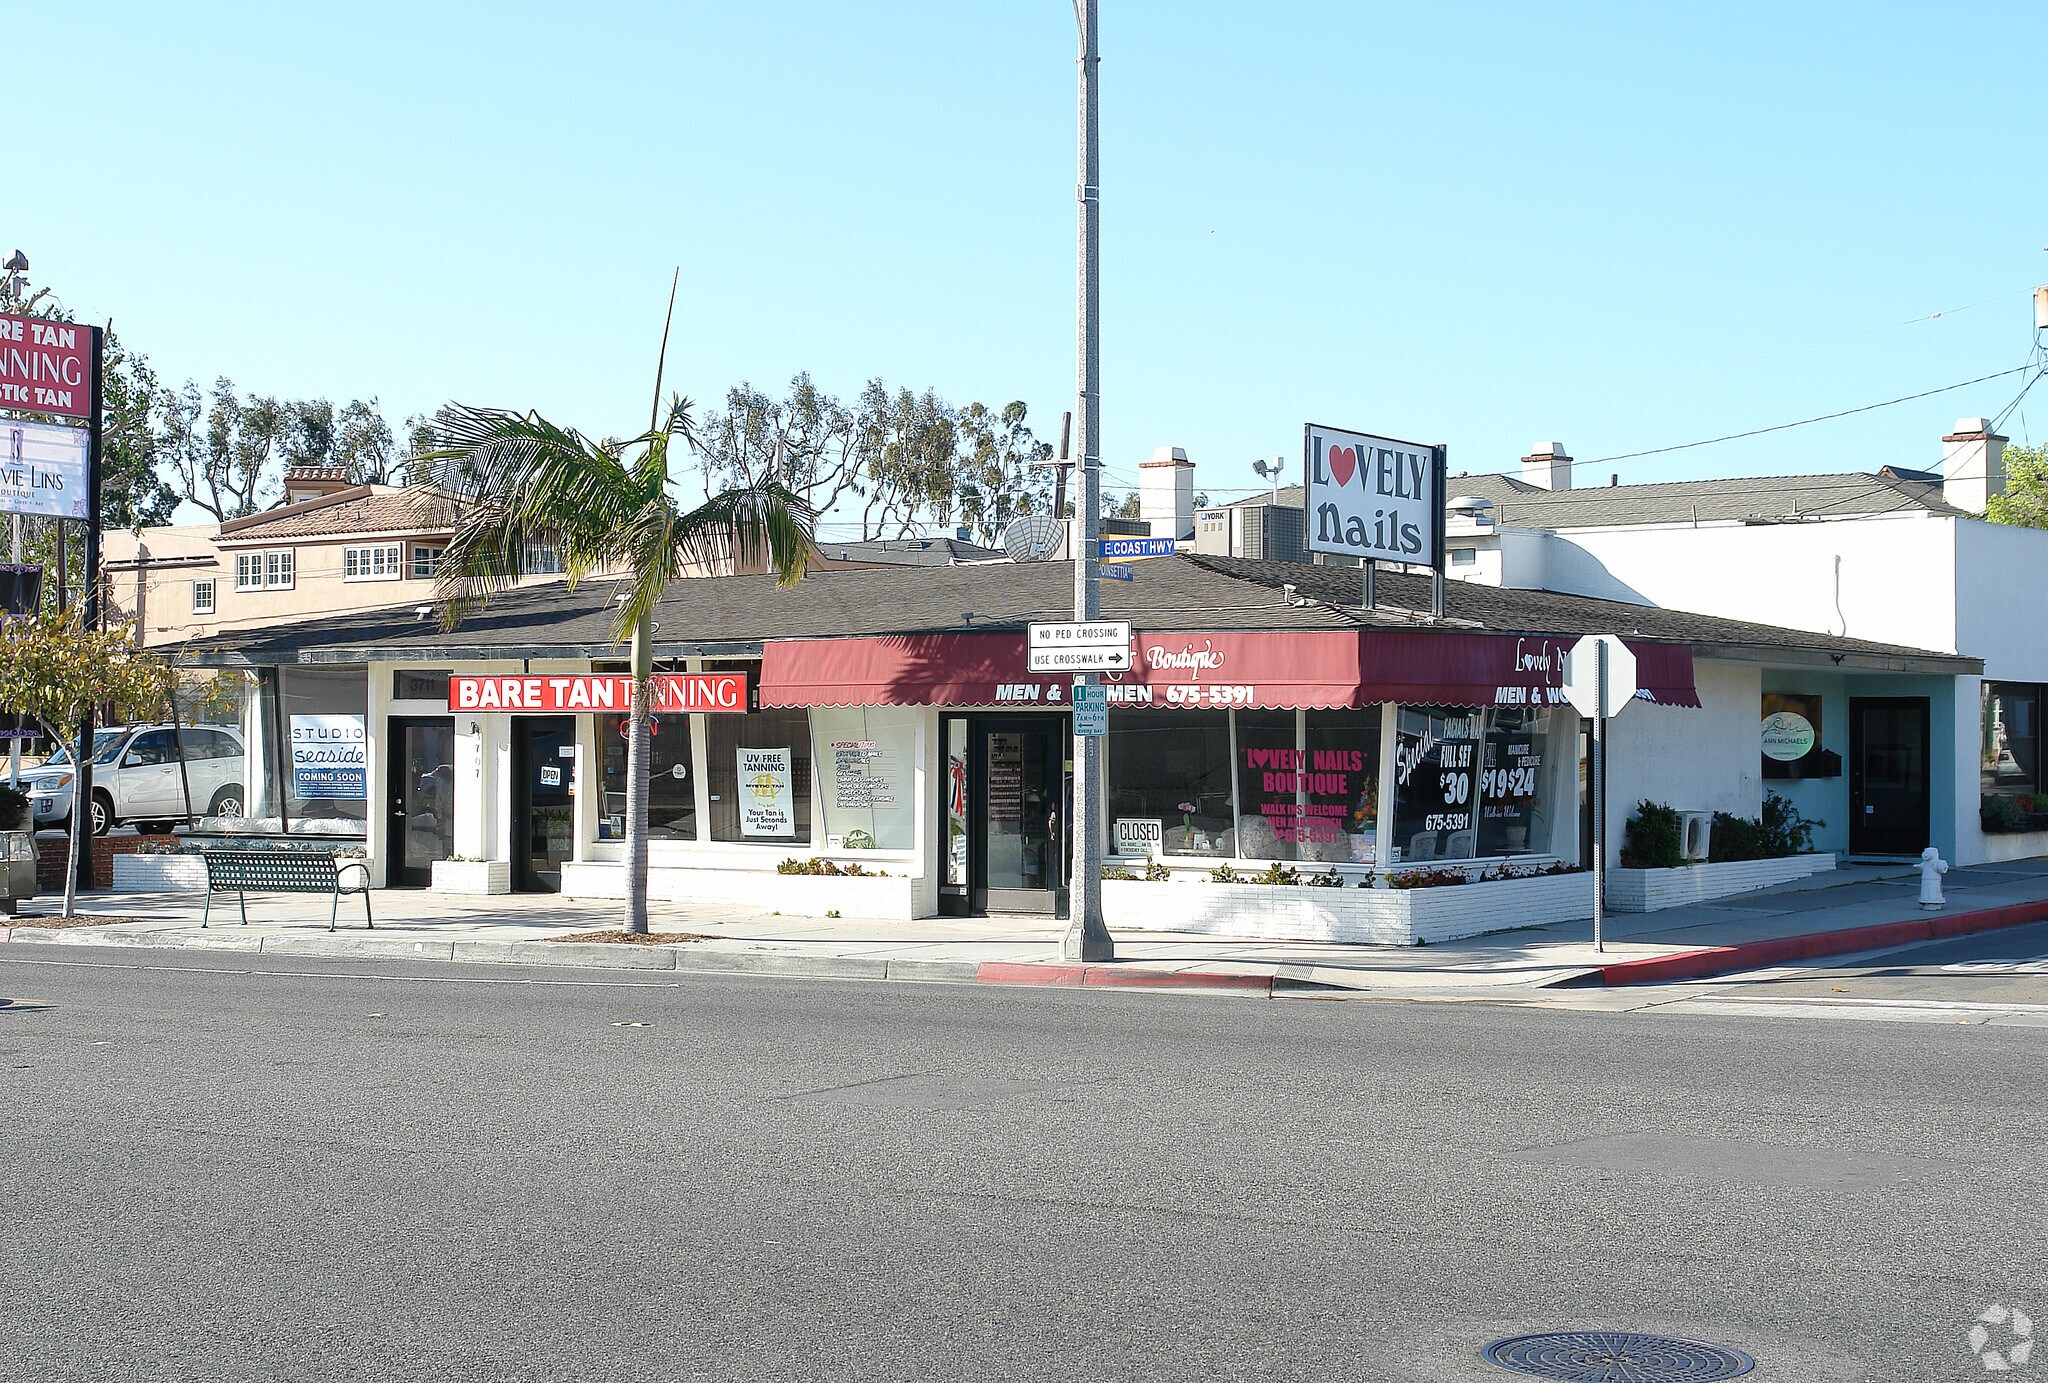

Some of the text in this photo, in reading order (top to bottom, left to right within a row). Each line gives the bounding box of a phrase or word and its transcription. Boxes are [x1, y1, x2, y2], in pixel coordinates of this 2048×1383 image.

[31, 323, 76, 350] TAN
[0, 383, 72, 408] TIC TAN
[1150, 540, 1174, 554] HWY
[1039, 627, 1118, 639] NO PED CROSSING
[1034, 654, 1104, 664] USE CROSSWALK
[410, 678, 434, 691] 3711
[459, 678, 738, 708] BARE TAN TNNING
[995, 684, 1041, 701] MEN
[1046, 683, 1062, 701] &
[1165, 684, 1255, 704] 675-5391
[1077, 687, 1104, 700] 1 HOUR
[1494, 686, 1527, 704] MEN
[1531, 686, 1542, 704] &
[1075, 702, 1105, 712] PARKING
[293, 728, 363, 739] STUDIO
[1443, 717, 1470, 739] FACIALS
[1396, 714, 1434, 786] Special
[1440, 745, 1472, 768] FULL SET
[746, 754, 782, 763] UV FREE
[1313, 750, 1363, 772] NAILS
[743, 763, 785, 772] TANNING
[298, 772, 363, 781] COMING SOON
[1262, 771, 1348, 795] BOUTIQUE
[1482, 769, 1508, 799] $19
[1508, 767, 1535, 797] $24
[1439, 772, 1469, 805] $30
[748, 808, 764, 817] Your
[1261, 803, 1348, 816] WALK INS WELCOME
[756, 823, 778, 832] Away!
[1267, 816, 1287, 827] MEN
[1288, 817, 1306, 828] AND
[1120, 822, 1159, 841] CLOSED
[1284, 829, 1338, 844] 675-5391
